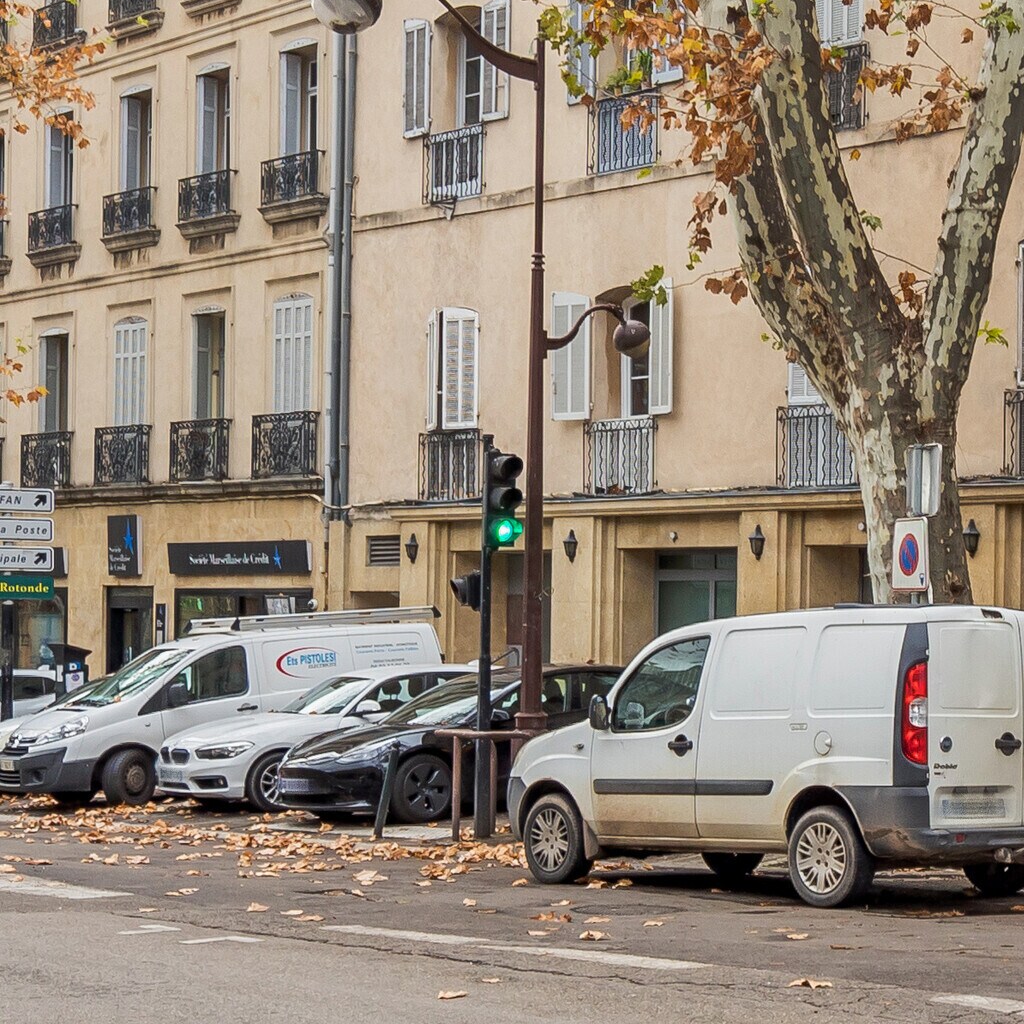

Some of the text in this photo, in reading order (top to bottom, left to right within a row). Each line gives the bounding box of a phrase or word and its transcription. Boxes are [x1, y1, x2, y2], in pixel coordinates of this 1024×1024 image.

[15, 524, 48, 535] Poste
[208, 552, 242, 565] Marseillaise
[242, 552, 250, 564] de
[0, 582, 50, 593] Rotonde
[286, 656, 298, 666] Ets
